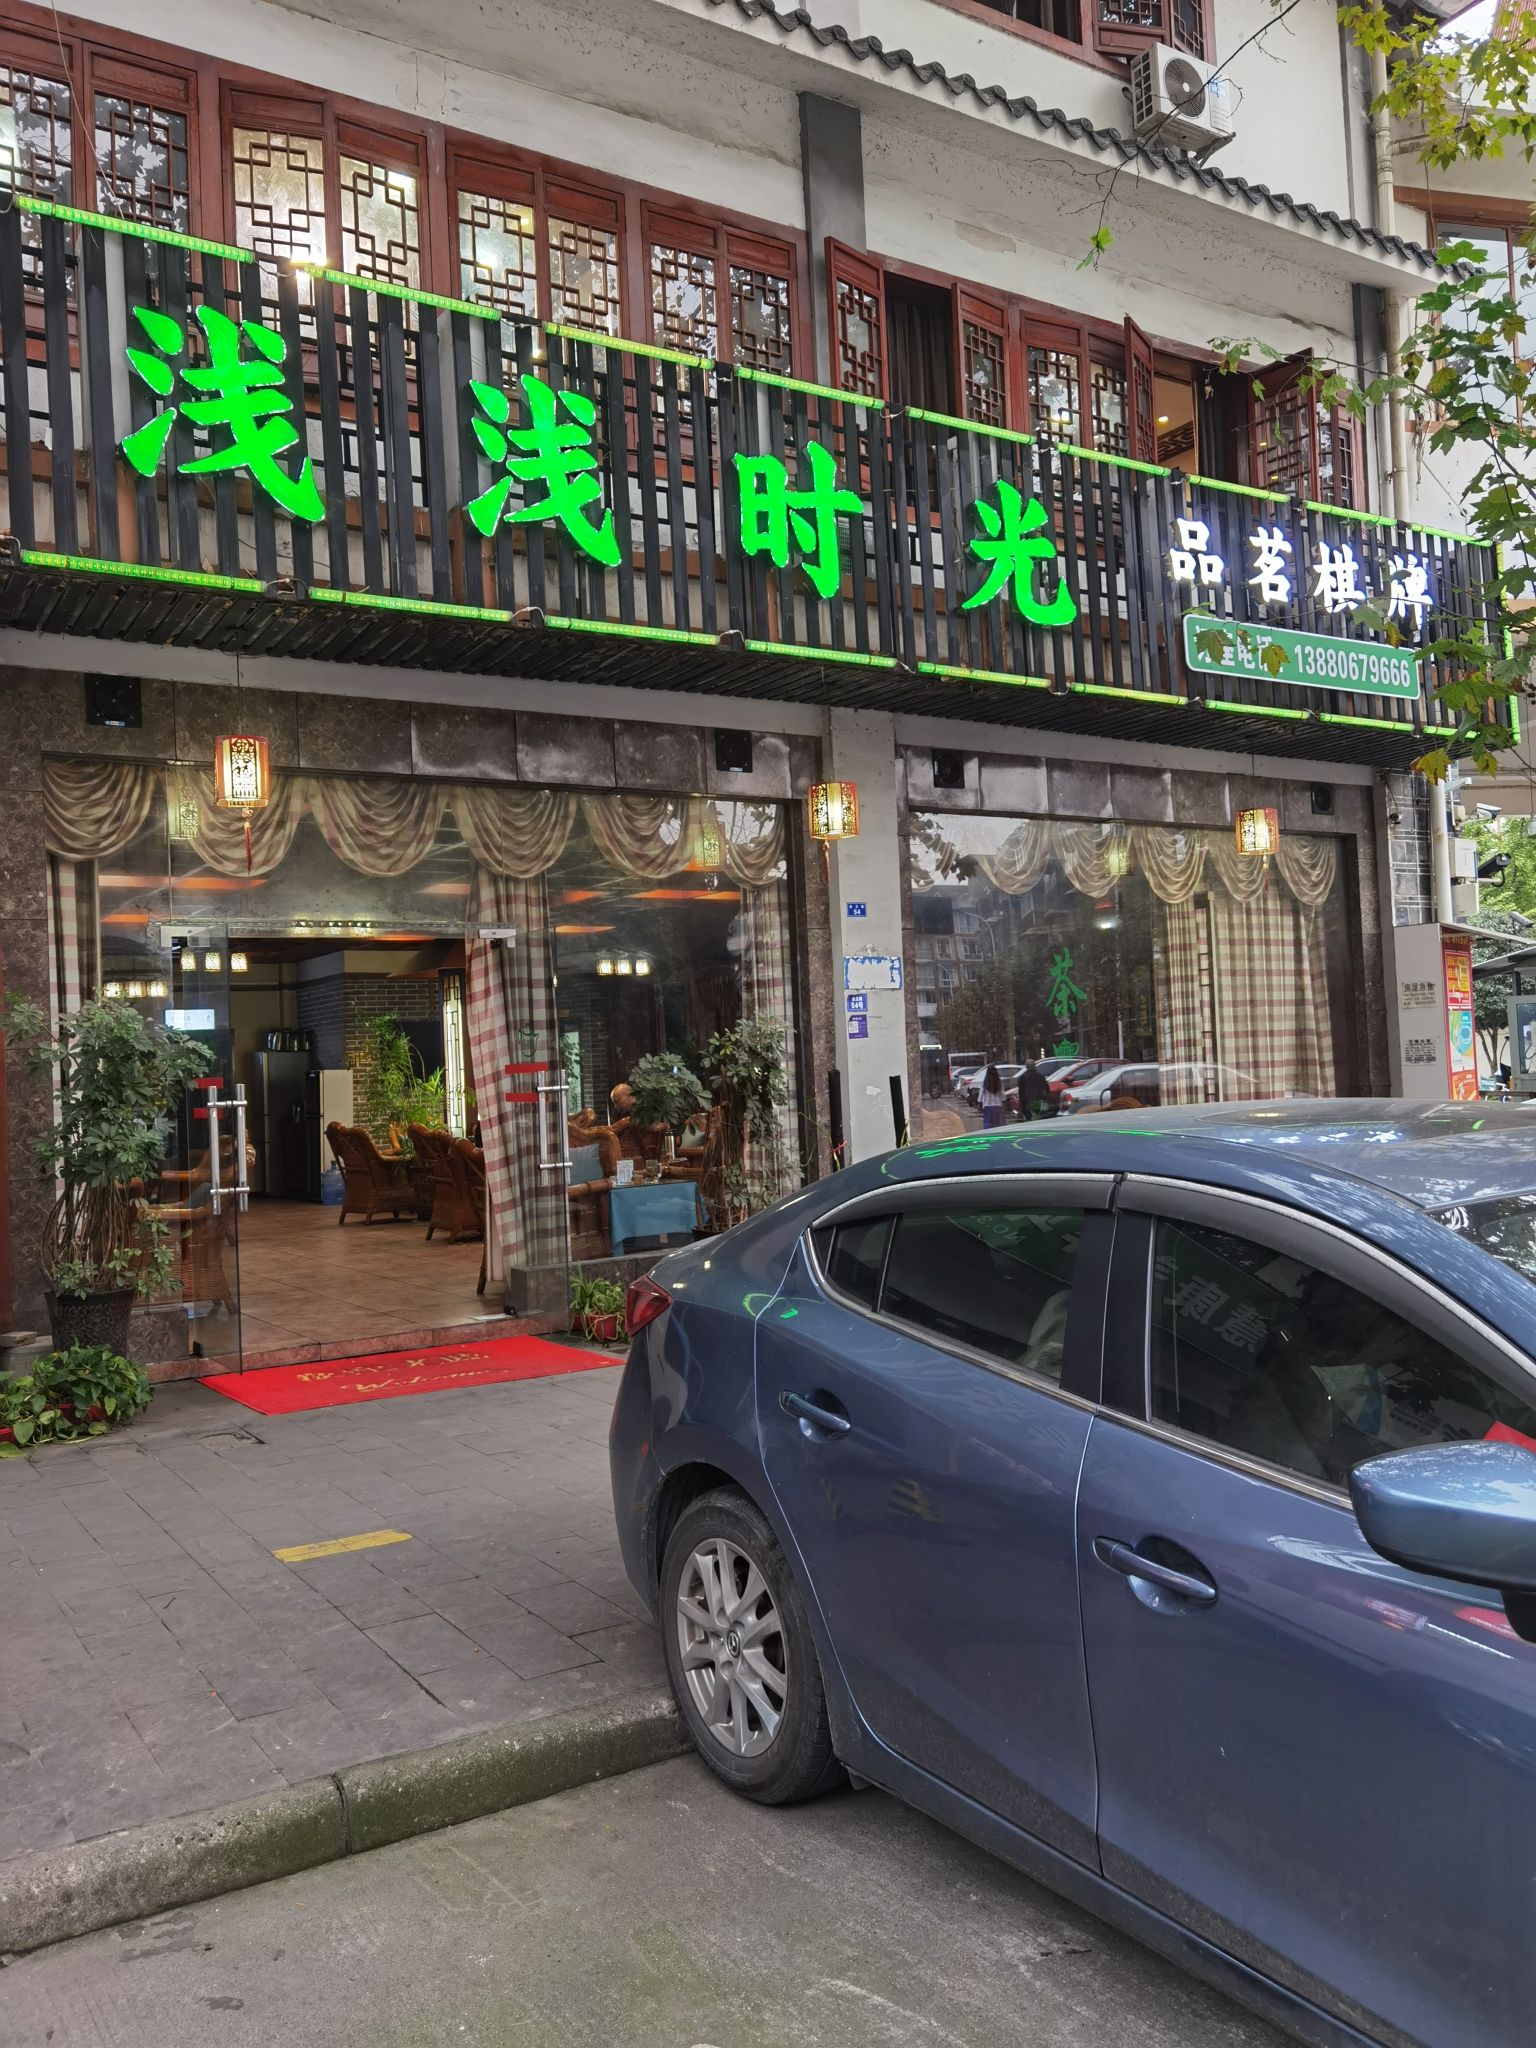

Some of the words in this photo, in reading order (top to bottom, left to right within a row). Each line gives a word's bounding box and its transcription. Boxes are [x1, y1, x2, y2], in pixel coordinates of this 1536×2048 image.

[119, 304, 1077, 627] 浅浅时光
[1168, 517, 1434, 629] 品茗棋牌
[1293, 643, 1411, 688] 13880679666
[1045, 947, 1088, 1017] 茶
